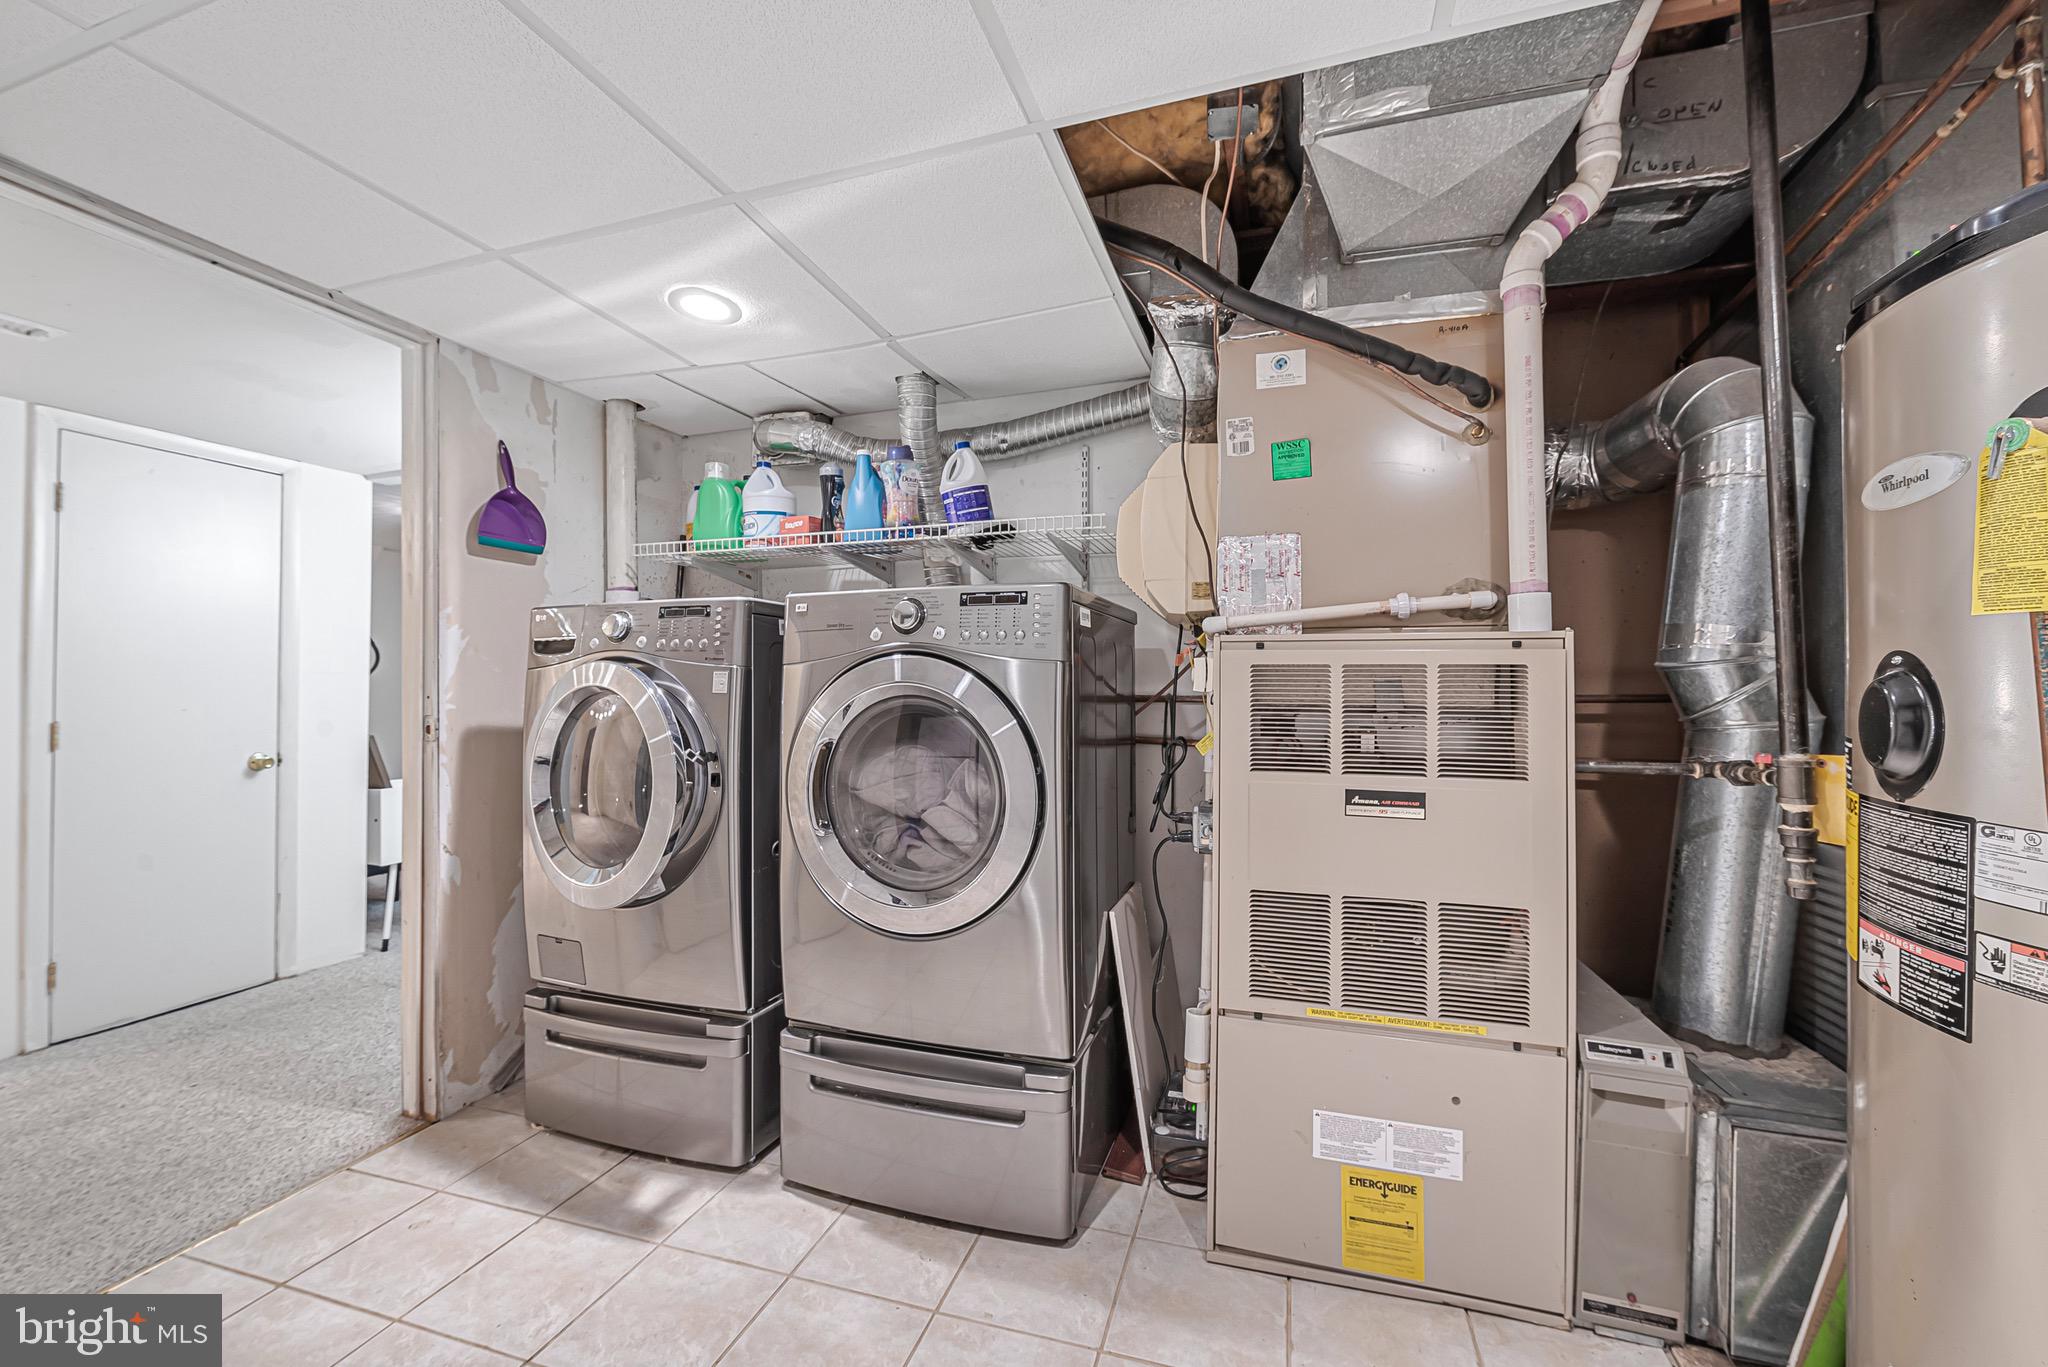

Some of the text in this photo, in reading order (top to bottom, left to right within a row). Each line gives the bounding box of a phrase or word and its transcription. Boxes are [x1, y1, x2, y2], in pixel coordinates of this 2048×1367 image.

[1657, 99, 1722, 120] OPEN
[1276, 439, 1306, 450] WSSC
[1880, 468, 1929, 493] Whirlpool
[1885, 934, 1922, 955] DANGER
[1311, 1008, 1336, 1017] WARNING:
[1387, 1017, 1433, 1028] AVERTISSEMENT:
[1598, 1044, 1632, 1055] Honeywell
